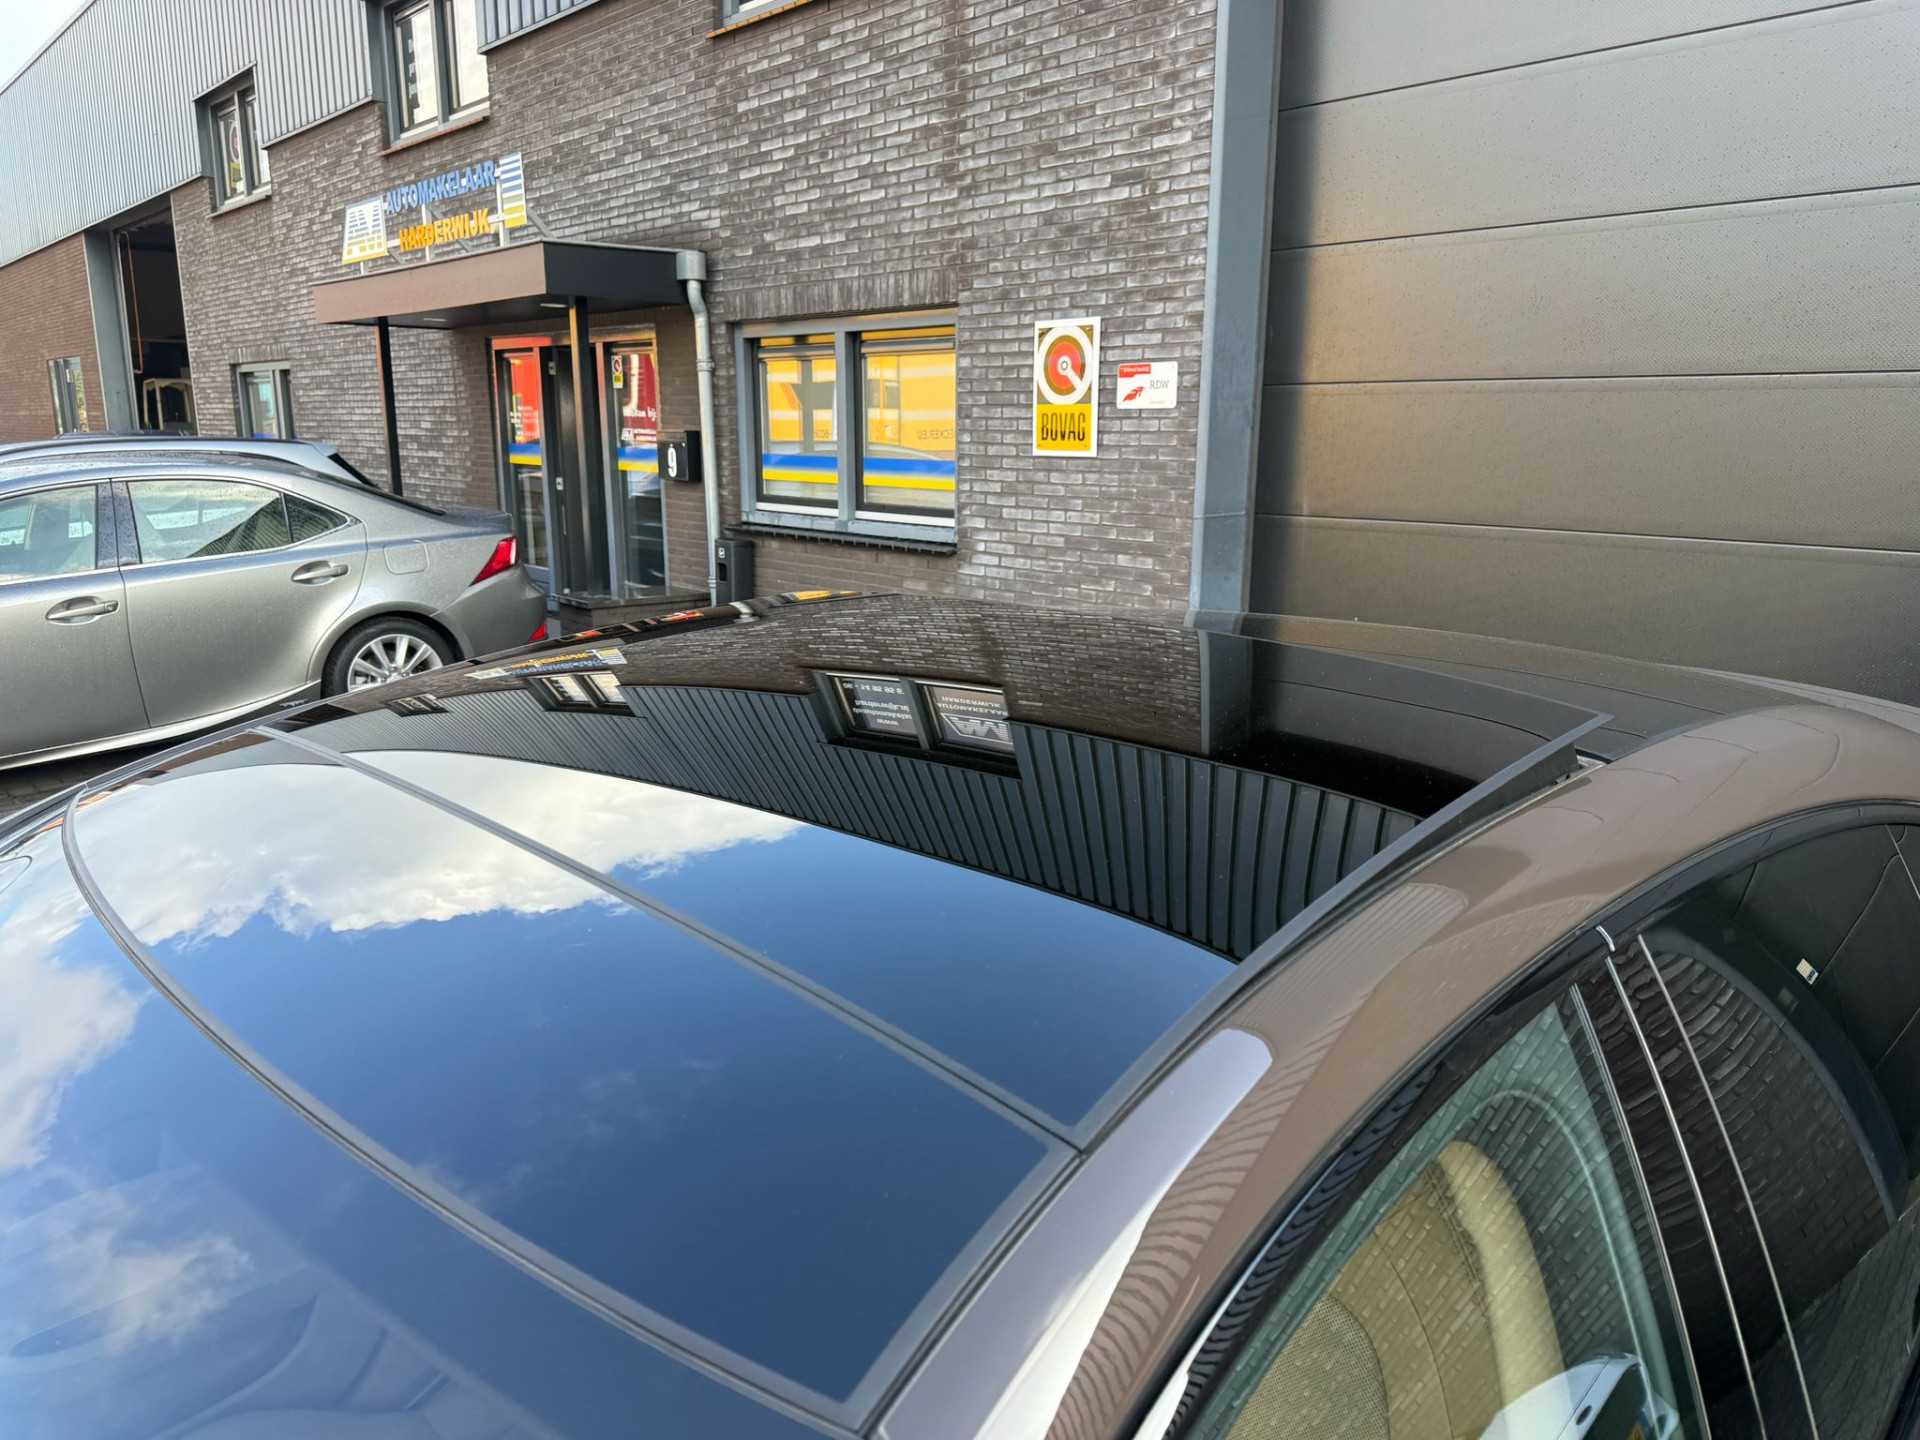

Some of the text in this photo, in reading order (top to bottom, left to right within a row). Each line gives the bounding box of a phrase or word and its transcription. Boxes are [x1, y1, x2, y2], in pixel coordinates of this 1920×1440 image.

[386, 160, 496, 215] AUTOMAKELAAR
[398, 208, 491, 252] HARDERWIJK
[1149, 379, 1170, 390] RDW
[1041, 412, 1086, 442] BOVAG
[667, 446, 678, 478] 9
